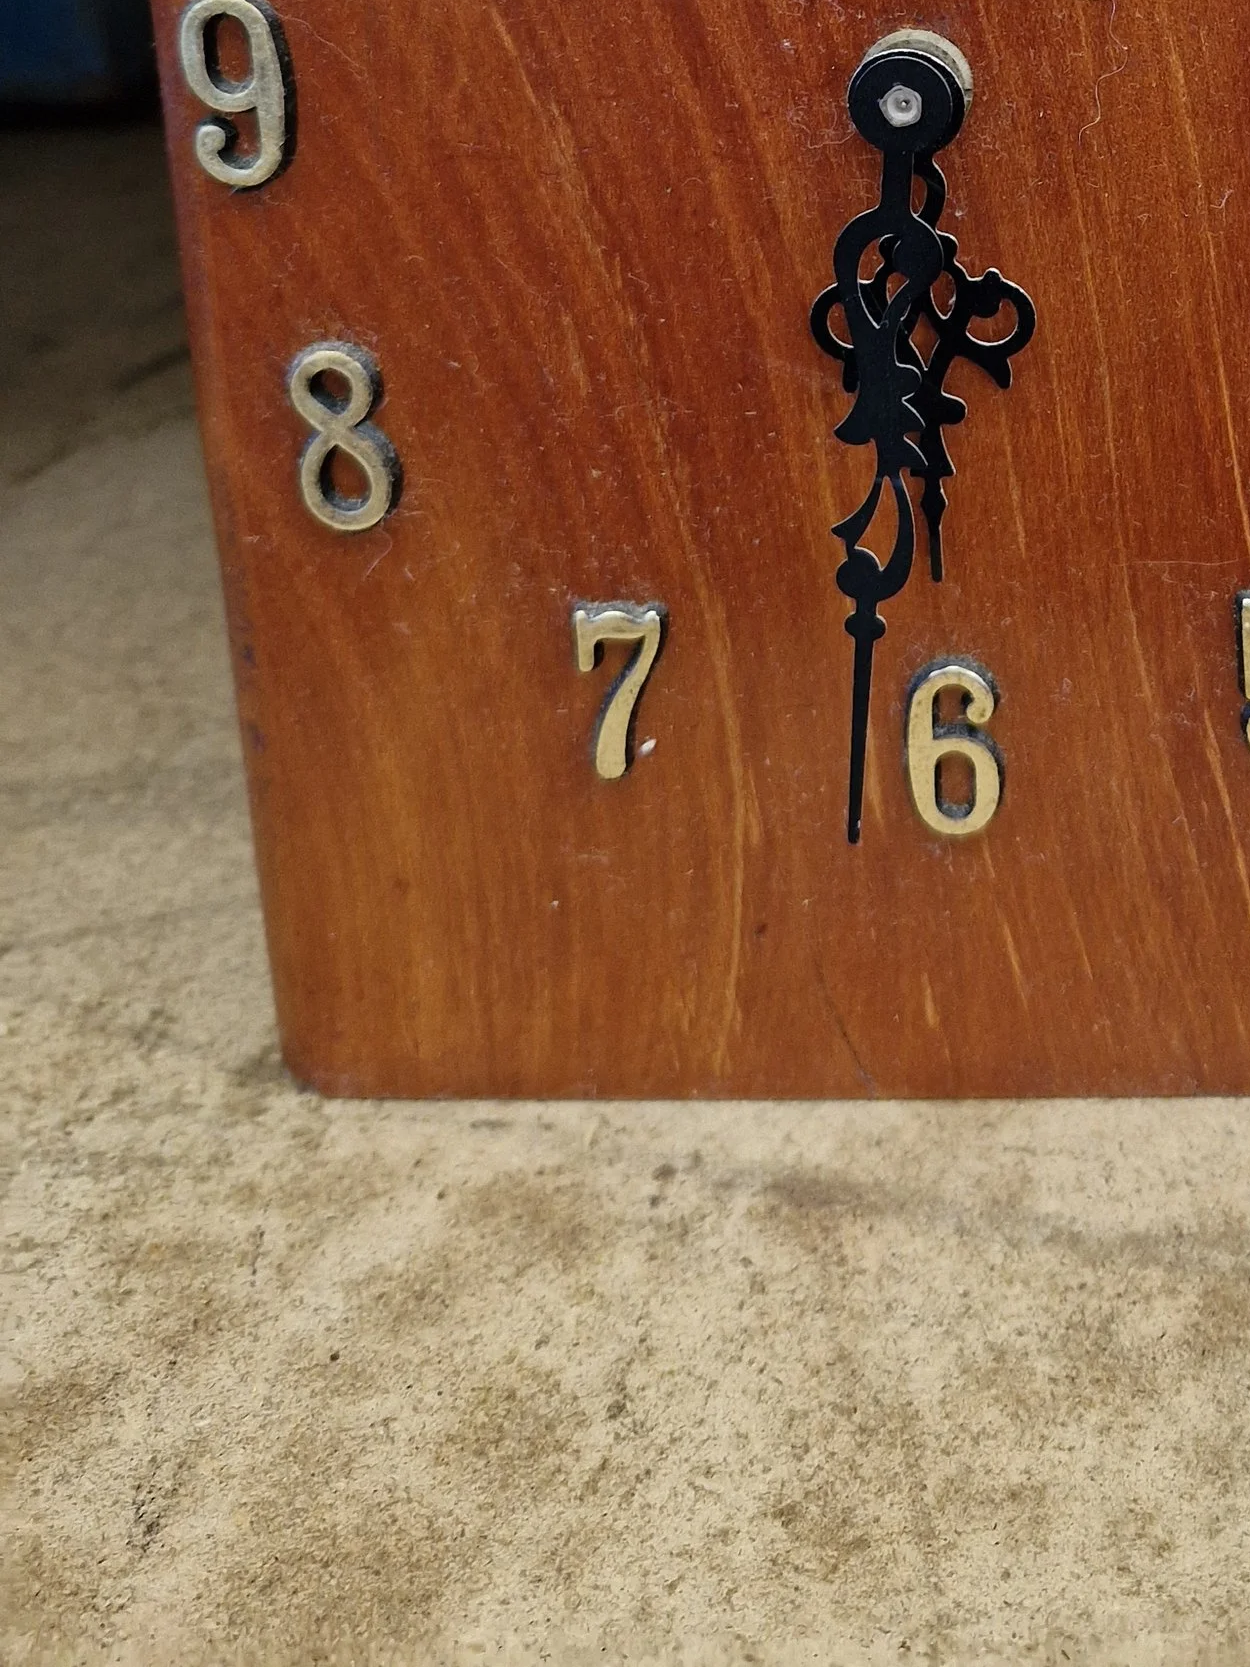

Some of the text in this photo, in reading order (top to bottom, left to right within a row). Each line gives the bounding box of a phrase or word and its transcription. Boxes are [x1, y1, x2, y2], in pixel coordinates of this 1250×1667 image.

[288, 344, 398, 532] 8
[573, 605, 664, 781] 7
[907, 665, 1001, 837] 6
